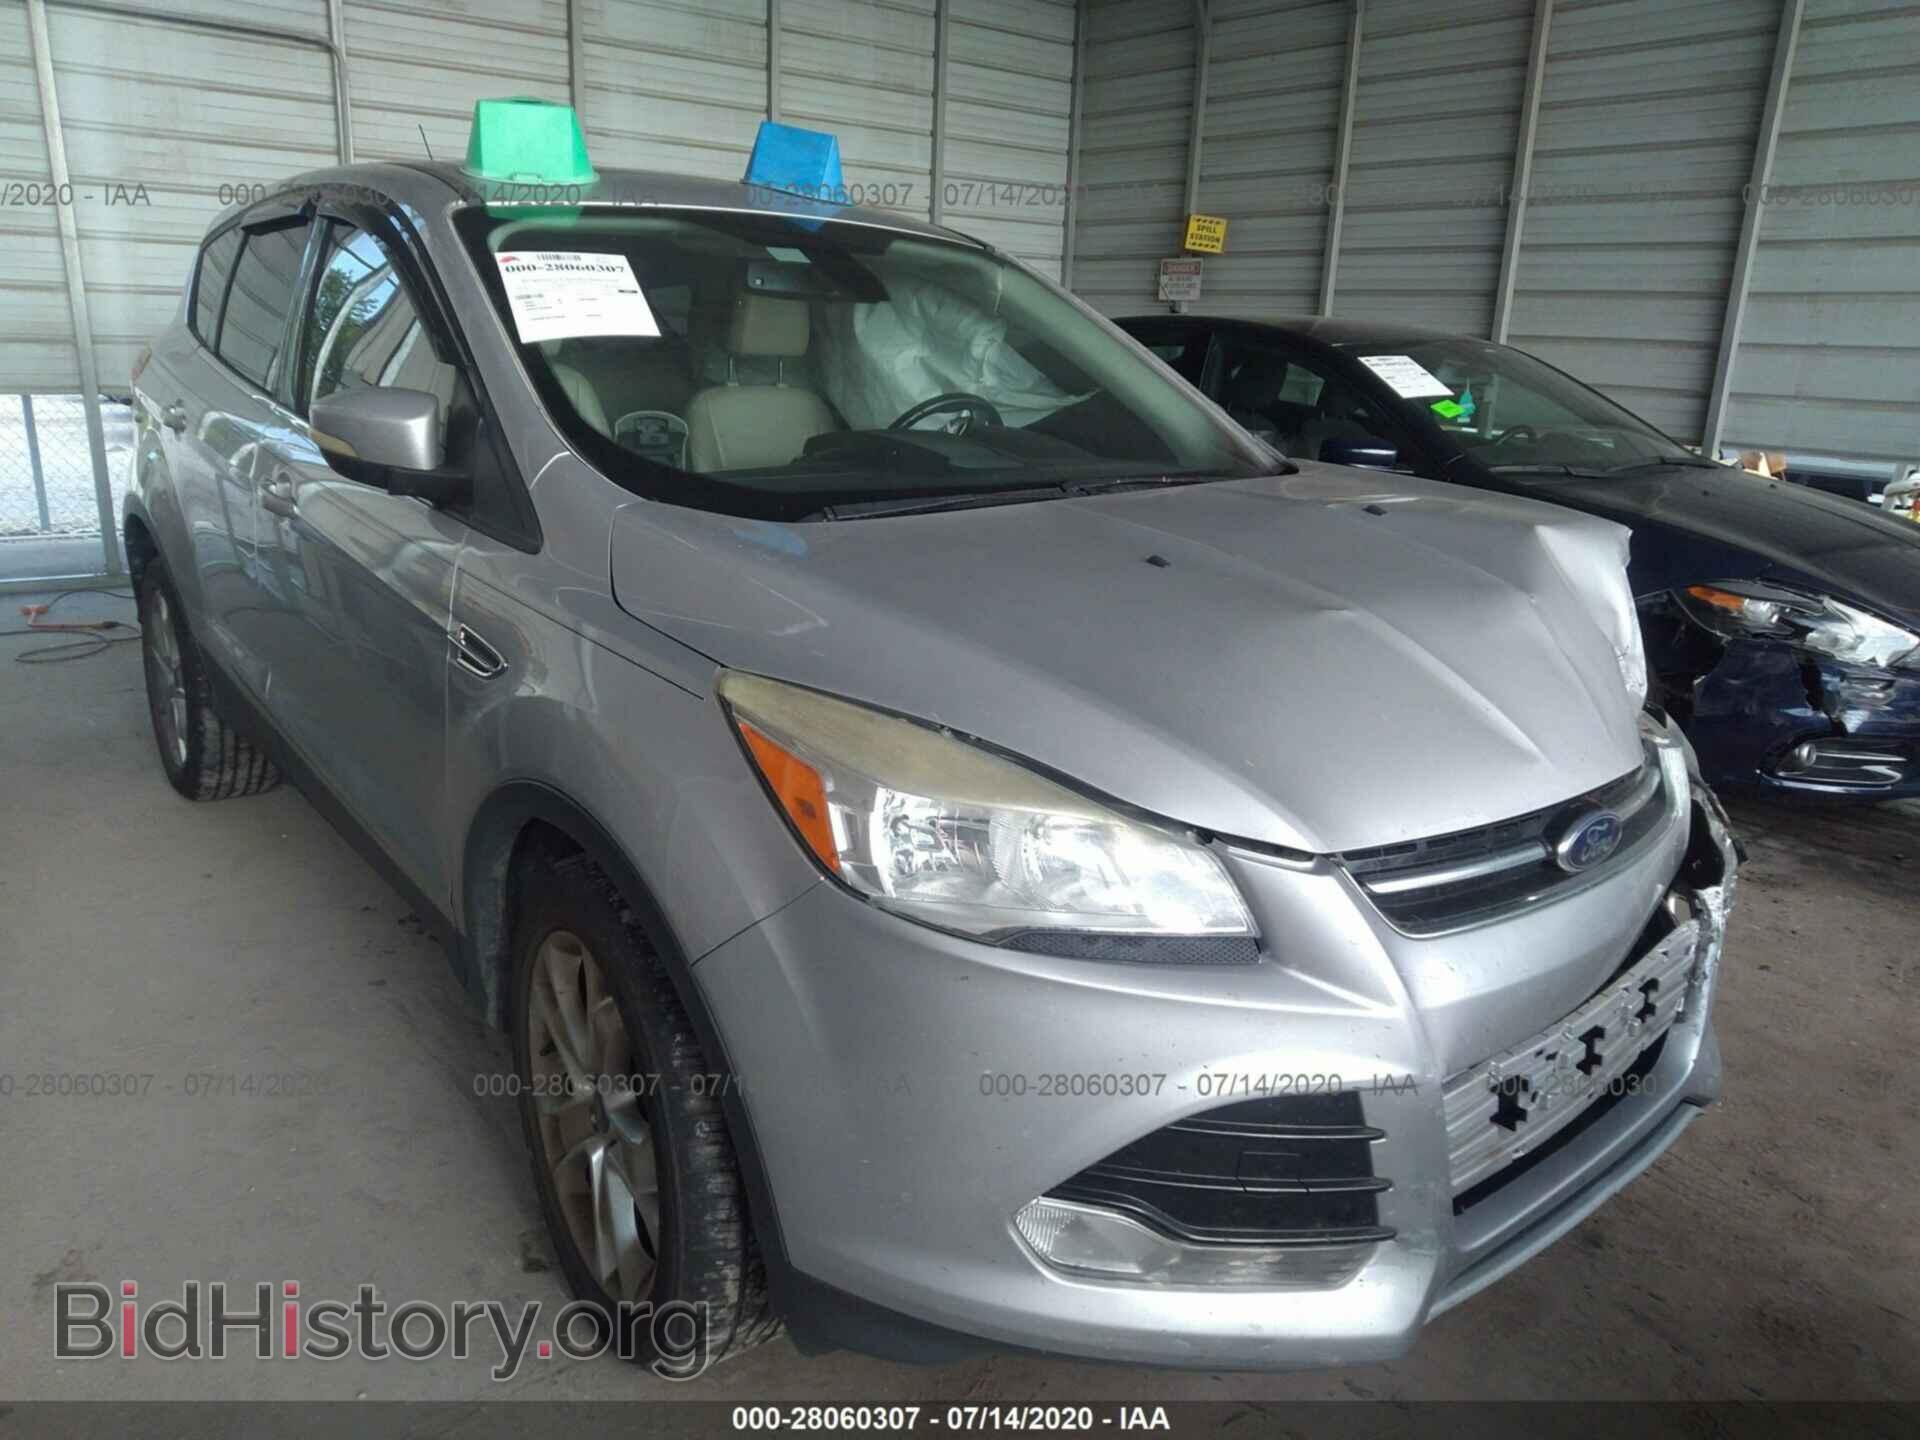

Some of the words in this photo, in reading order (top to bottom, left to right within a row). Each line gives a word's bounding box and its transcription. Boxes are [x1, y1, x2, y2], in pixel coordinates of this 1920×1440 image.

[1196, 225, 1217, 233] SPILL
[1189, 233, 1221, 243] STATION
[504, 263, 624, 273] 000-28060307
